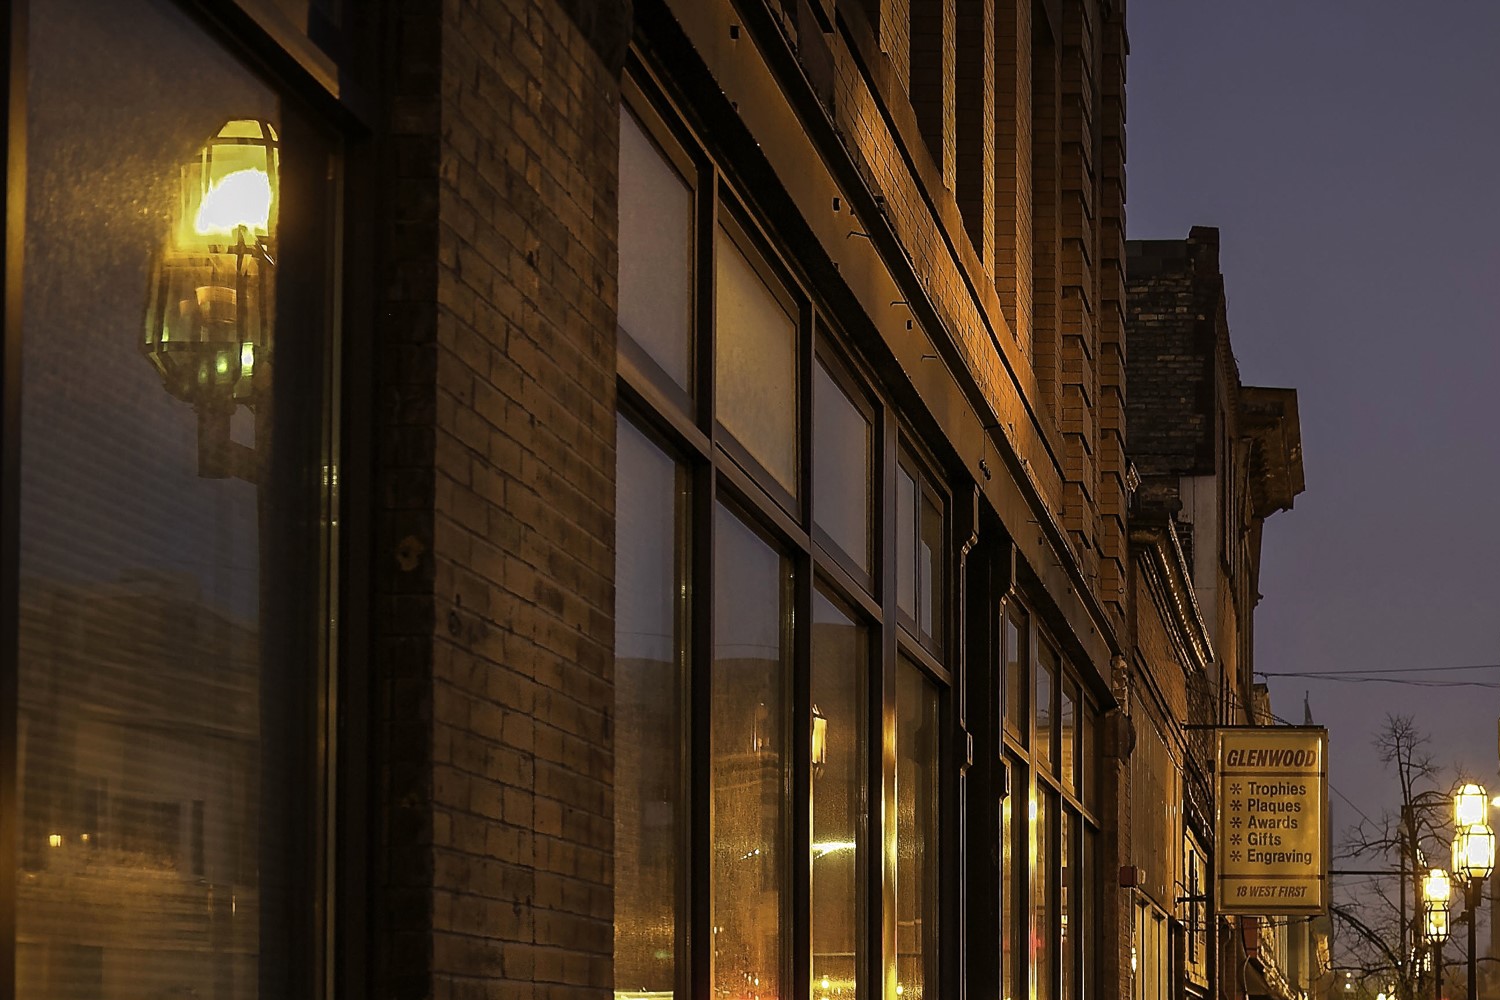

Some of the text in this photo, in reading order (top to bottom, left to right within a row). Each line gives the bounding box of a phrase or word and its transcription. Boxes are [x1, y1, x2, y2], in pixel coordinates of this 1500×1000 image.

[1227, 749, 1317, 768] GLENWOOD
[1247, 781, 1307, 798] Trophies
[1247, 798, 1301, 815] Plaques
[1247, 815, 1298, 829] Awards
[1247, 832, 1282, 846] Gifts
[1247, 848, 1312, 865] Engraving
[1236, 885, 1308, 898] 18 WEST FIRST
